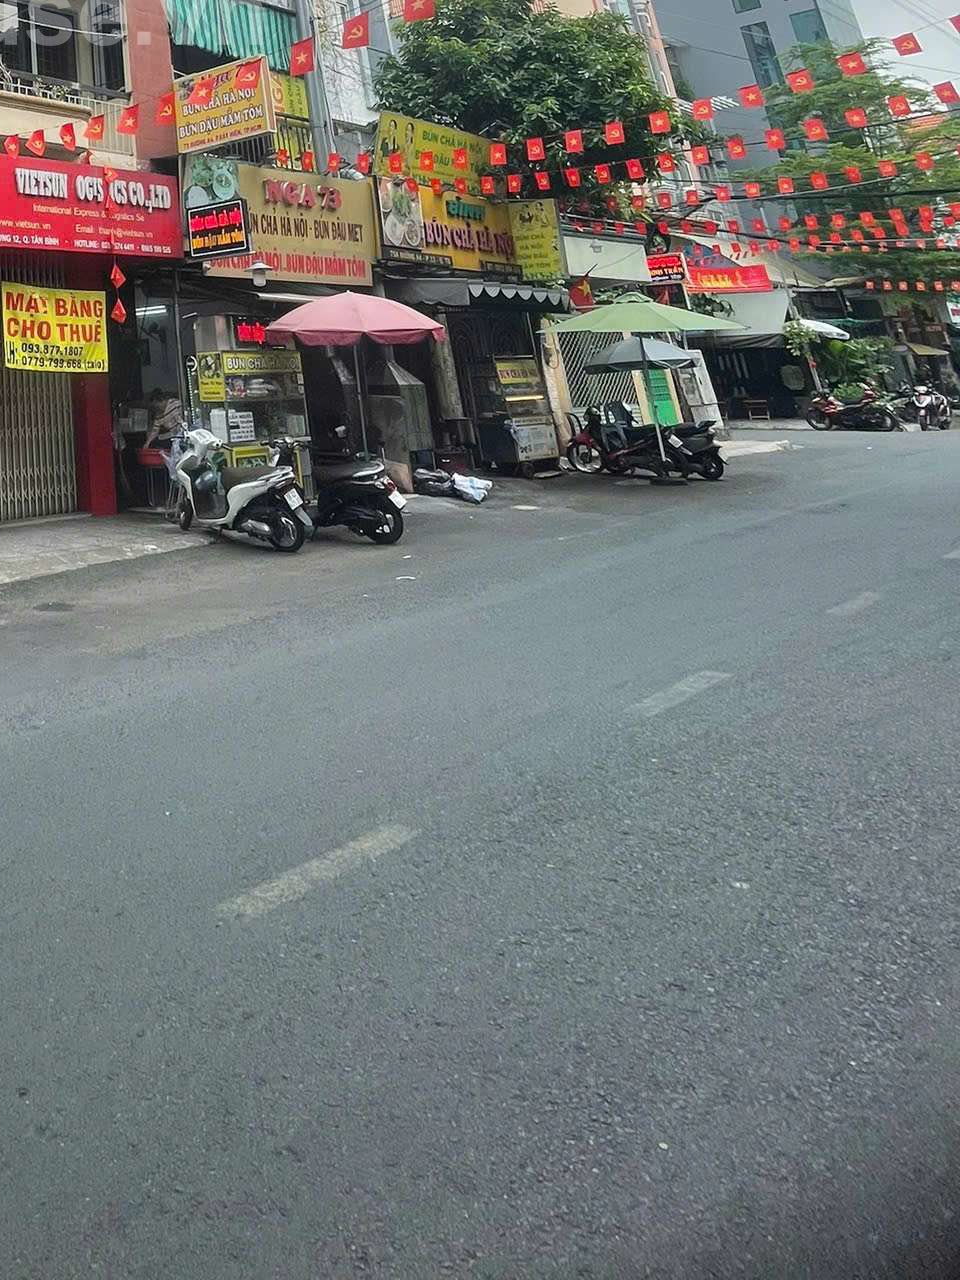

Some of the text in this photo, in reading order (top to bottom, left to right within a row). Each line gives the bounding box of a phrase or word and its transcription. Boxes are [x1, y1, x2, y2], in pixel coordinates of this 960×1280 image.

[15, 168, 68, 199] VIETSUN
[262, 178, 343, 210] NGA 73
[33, 203, 71, 216] International
[73, 206, 100, 219] Express
[261, 207, 278, 236] CHẢ
[280, 211, 292, 237] HÀ
[294, 212, 309, 242] NỘI
[314, 214, 330, 239] BÚN
[7, 318, 101, 343] CHO THUÊ
